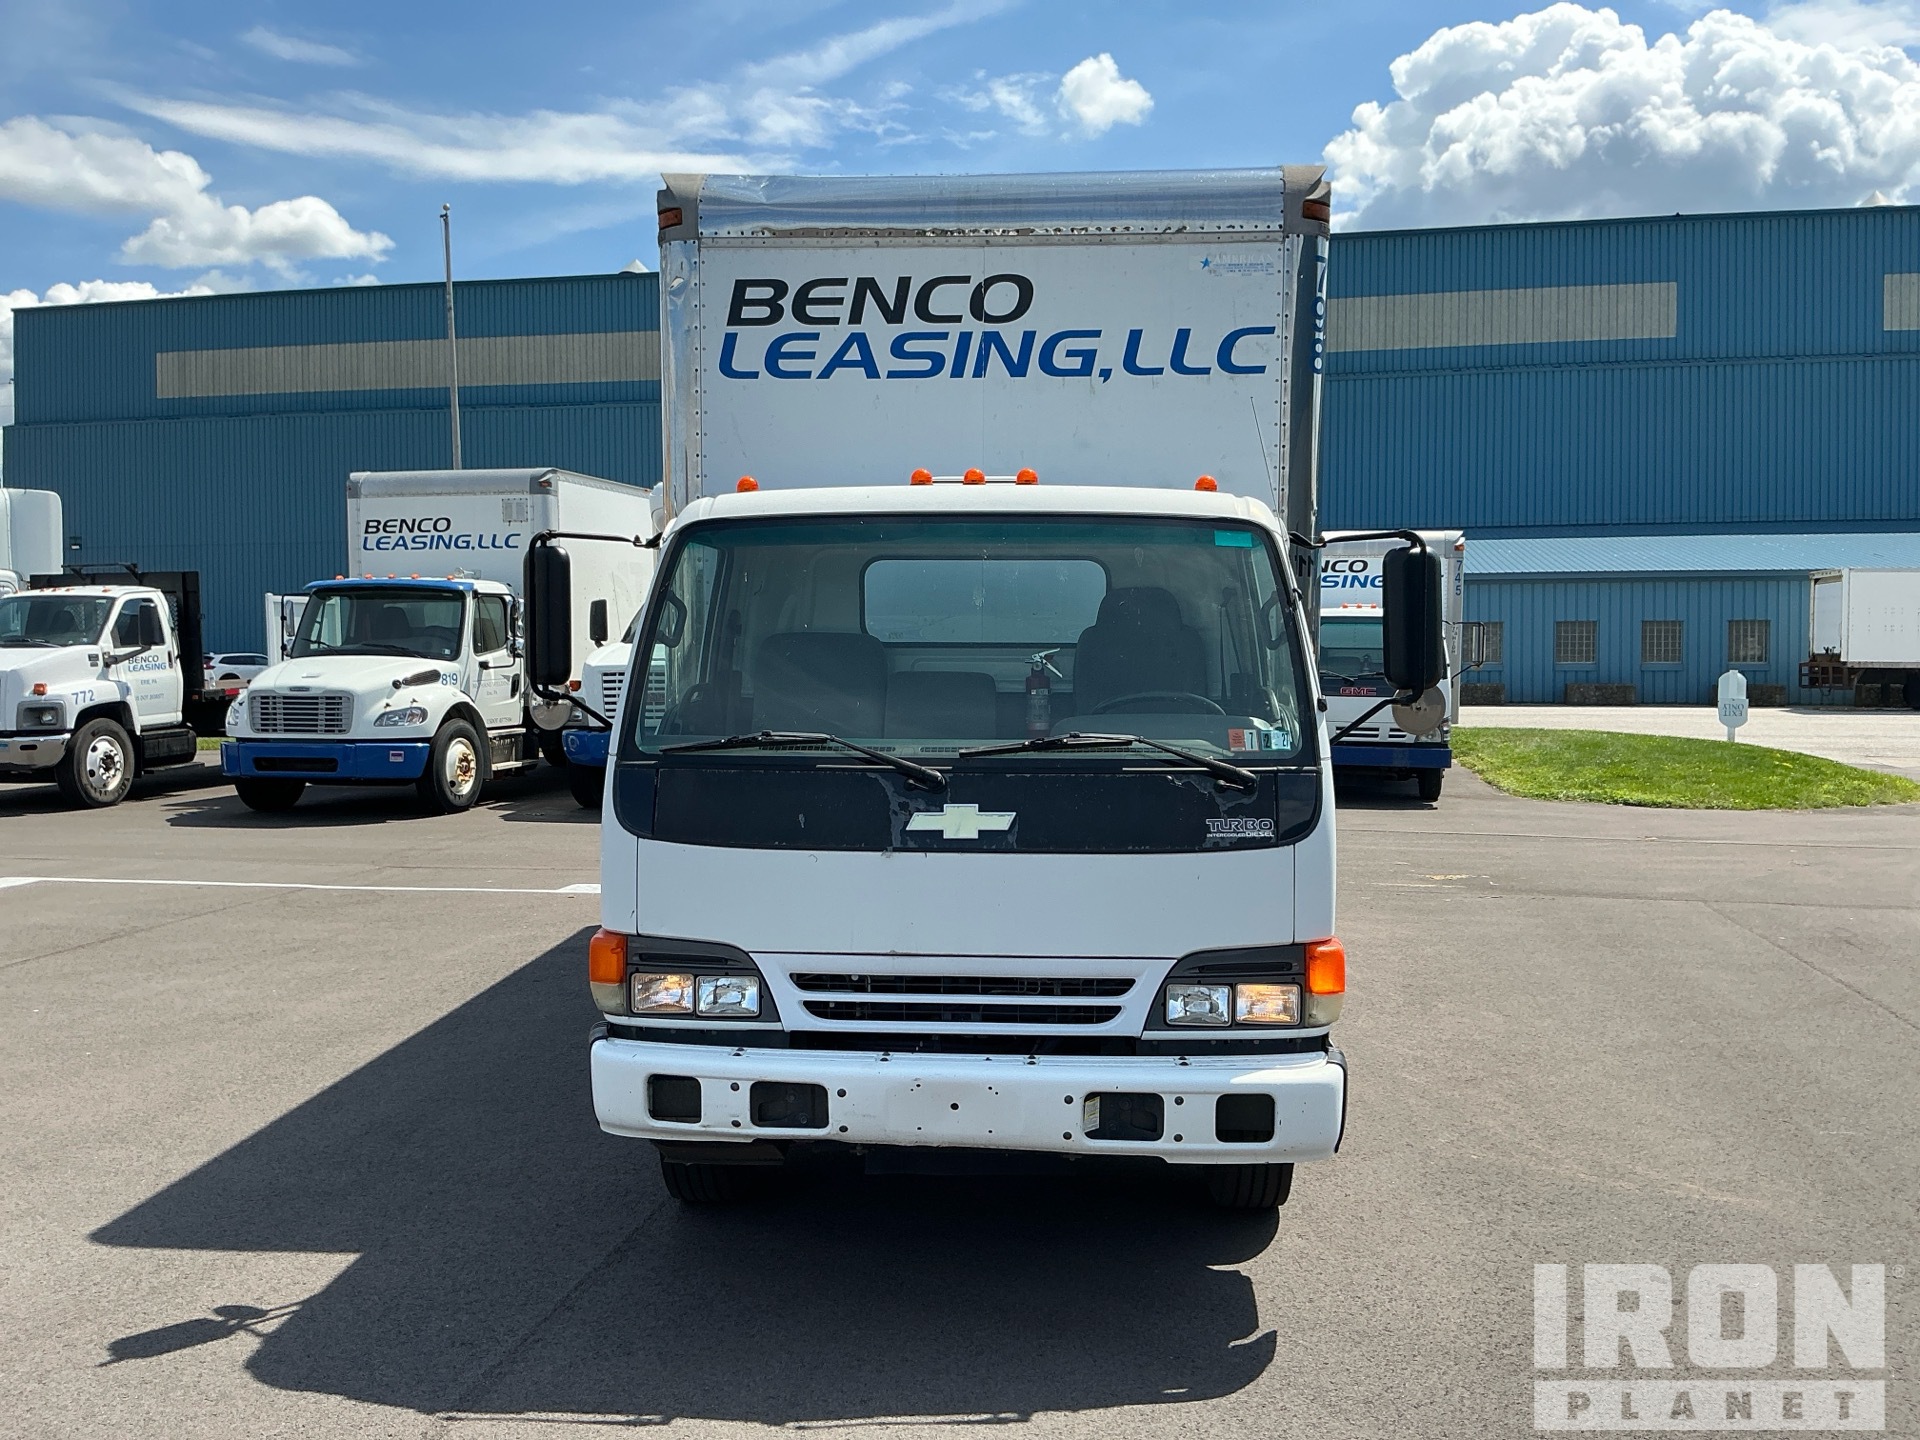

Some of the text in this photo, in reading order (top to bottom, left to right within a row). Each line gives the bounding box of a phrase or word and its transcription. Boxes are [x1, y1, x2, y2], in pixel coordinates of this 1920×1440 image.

[725, 273, 1034, 327] BENCO
[718, 326, 1276, 384] LEASING,LLC
[364, 517, 452, 534] BENCO
[1321, 560, 1369, 573] NCO
[1454, 560, 1463, 596] 745
[128, 655, 159, 664] BENCO
[128, 662, 167, 673] LEASING
[441, 673, 458, 685] 819
[71, 689, 96, 705] 772
[1340, 687, 1377, 696] GMC
[1205, 818, 1275, 832] TURBO
